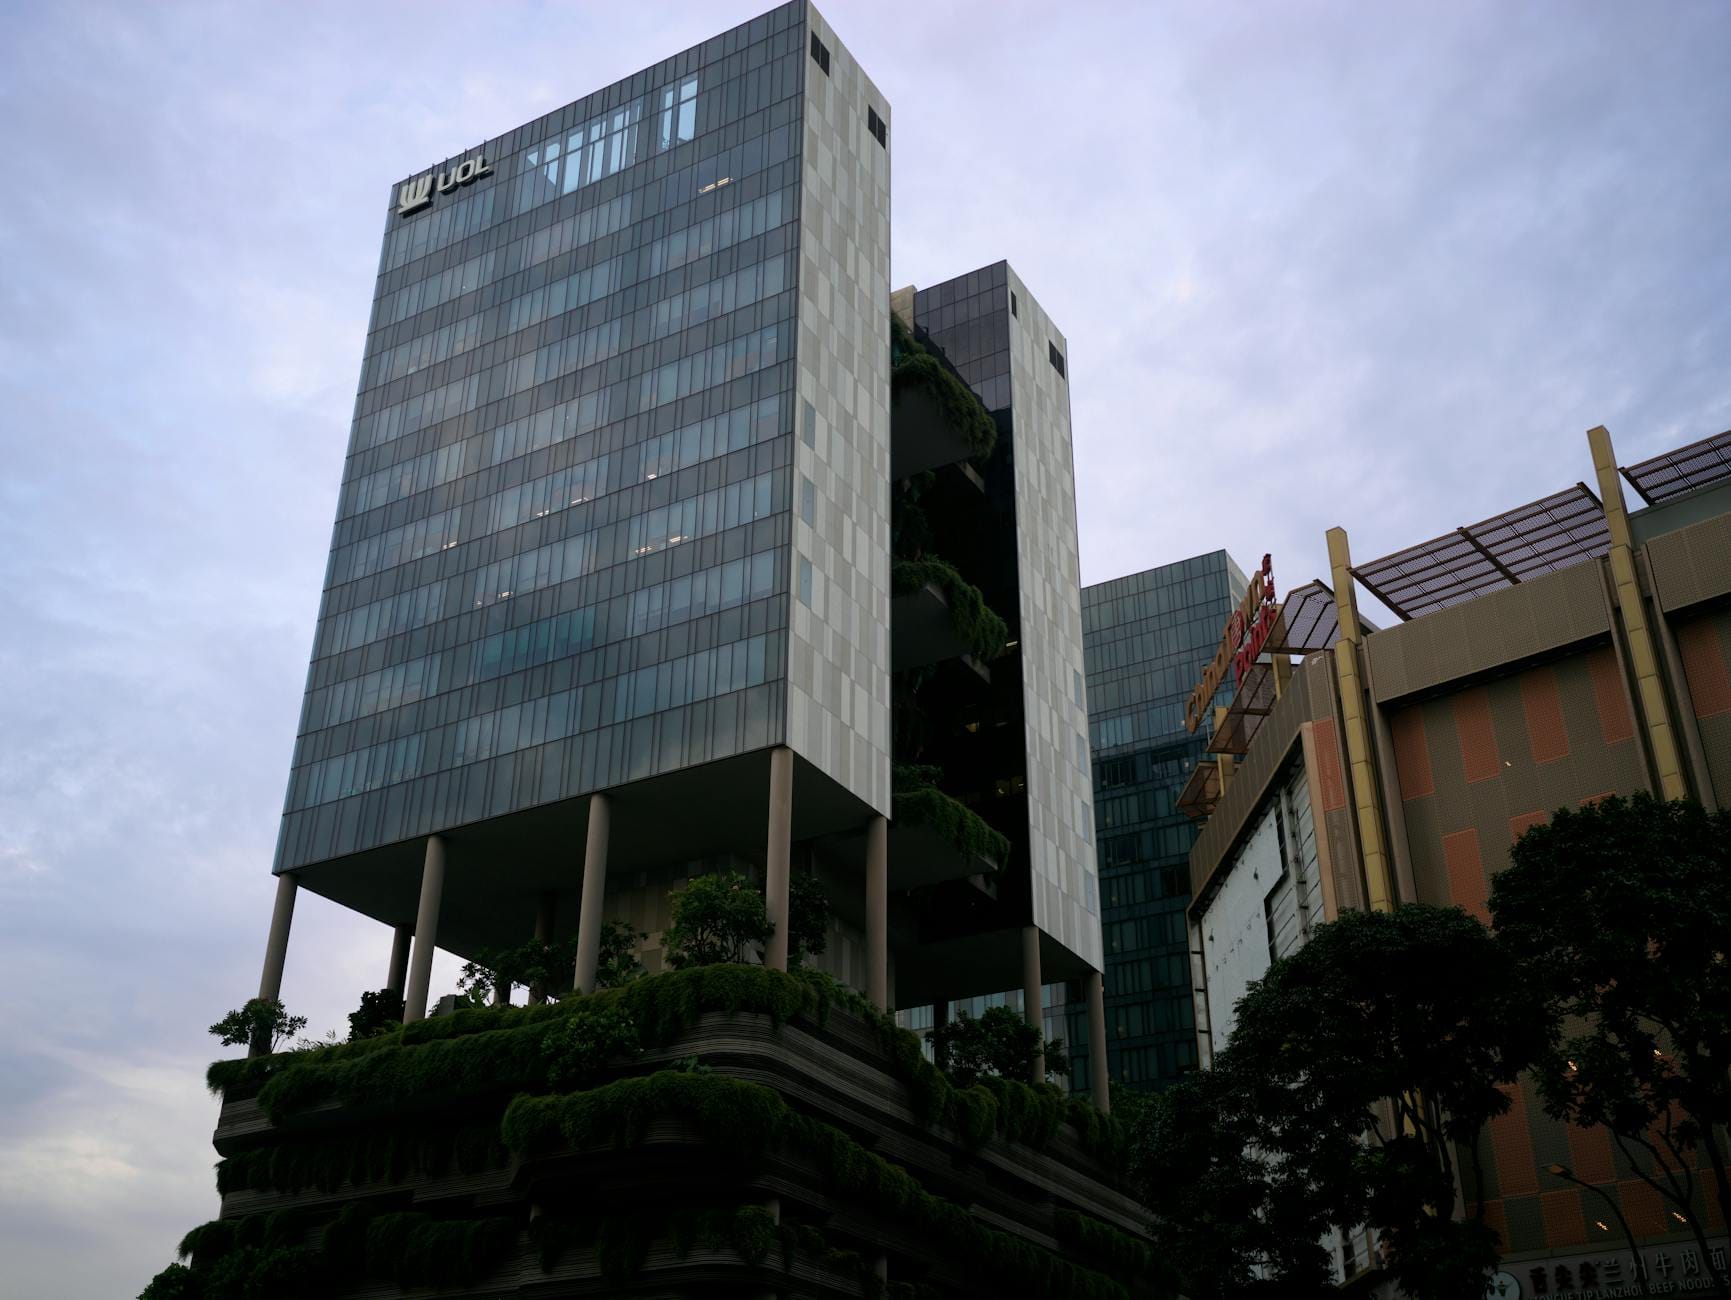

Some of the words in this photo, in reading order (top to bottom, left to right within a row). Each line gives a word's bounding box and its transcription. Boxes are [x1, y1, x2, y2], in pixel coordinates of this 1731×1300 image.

[437, 155, 490, 192] UOL
[1648, 1280, 1675, 1295] BEEF
[1678, 1275, 1730, 1290] NOODS
